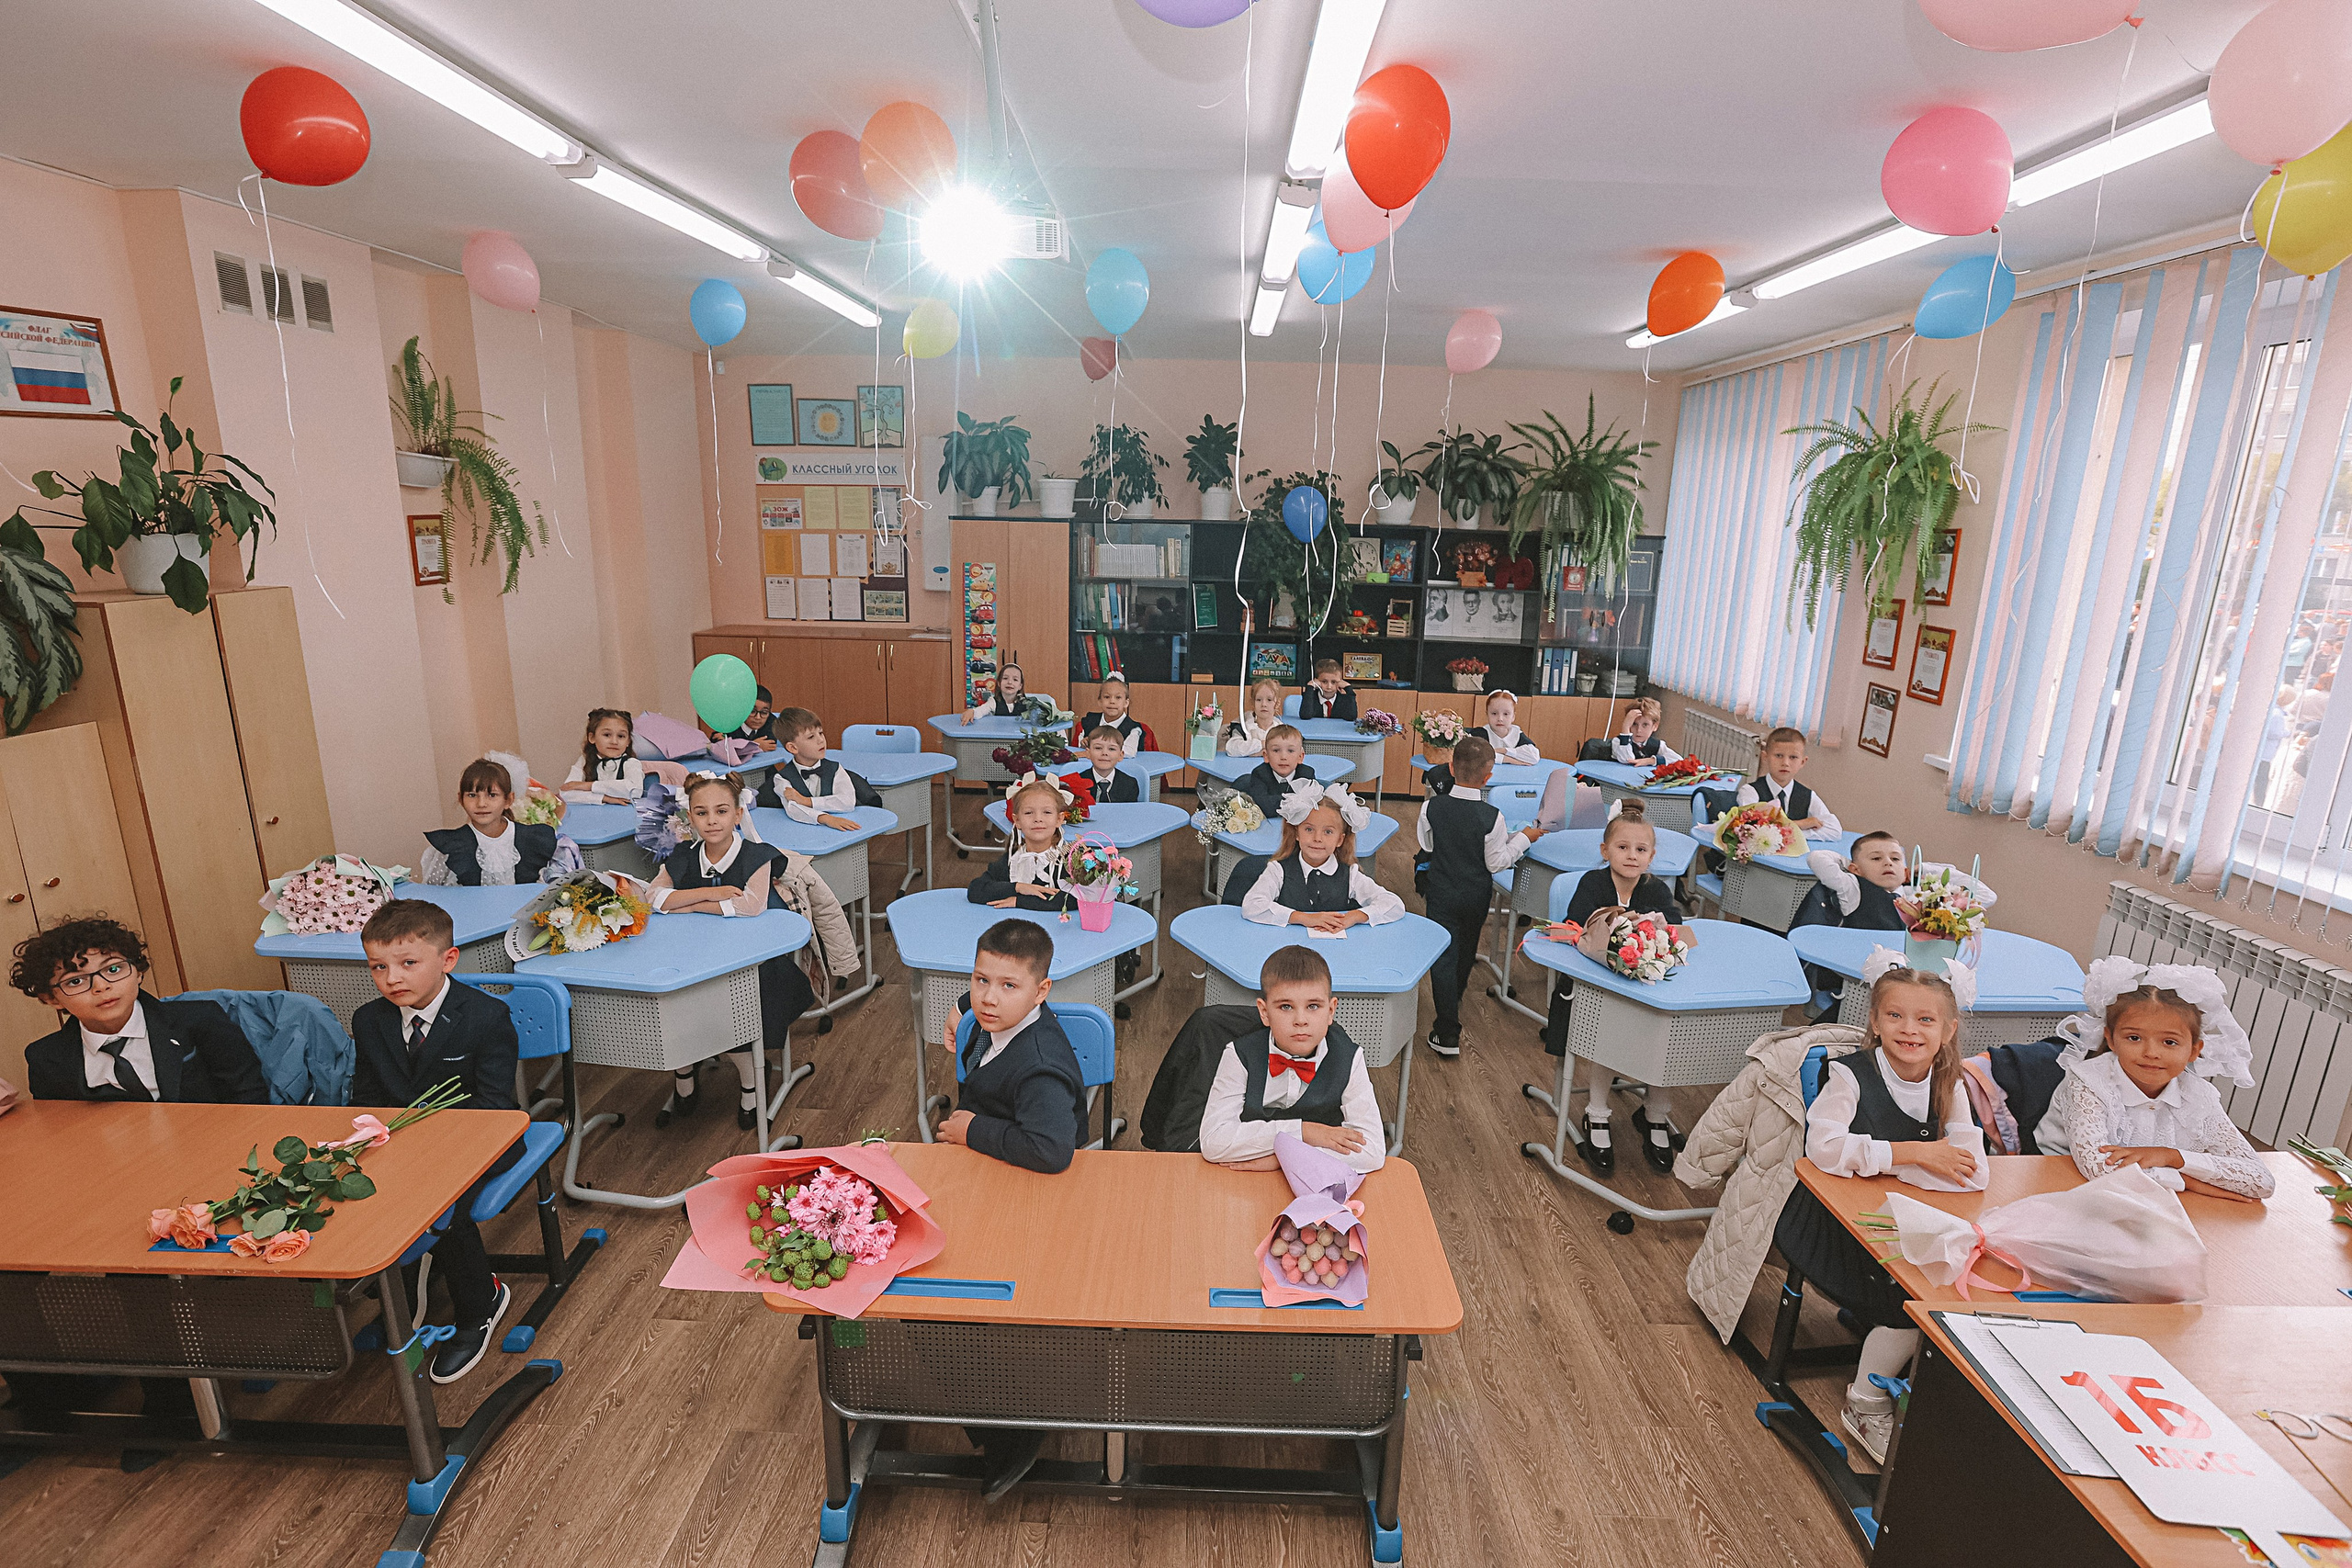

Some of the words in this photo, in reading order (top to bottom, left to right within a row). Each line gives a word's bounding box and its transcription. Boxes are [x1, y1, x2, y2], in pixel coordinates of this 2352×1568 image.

[28, 325, 52, 334] ФЛАГ
[44, 336, 96, 348] ФЕДЕРАЦИИ
[792, 463, 852, 474] КЛАССНЫЙ
[854, 465, 898, 475] УГОЛОК
[512, 926, 520, 941] LILY
[512, 942, 526, 958] KEFIR
[2060, 1371, 2212, 1439] 1Б
